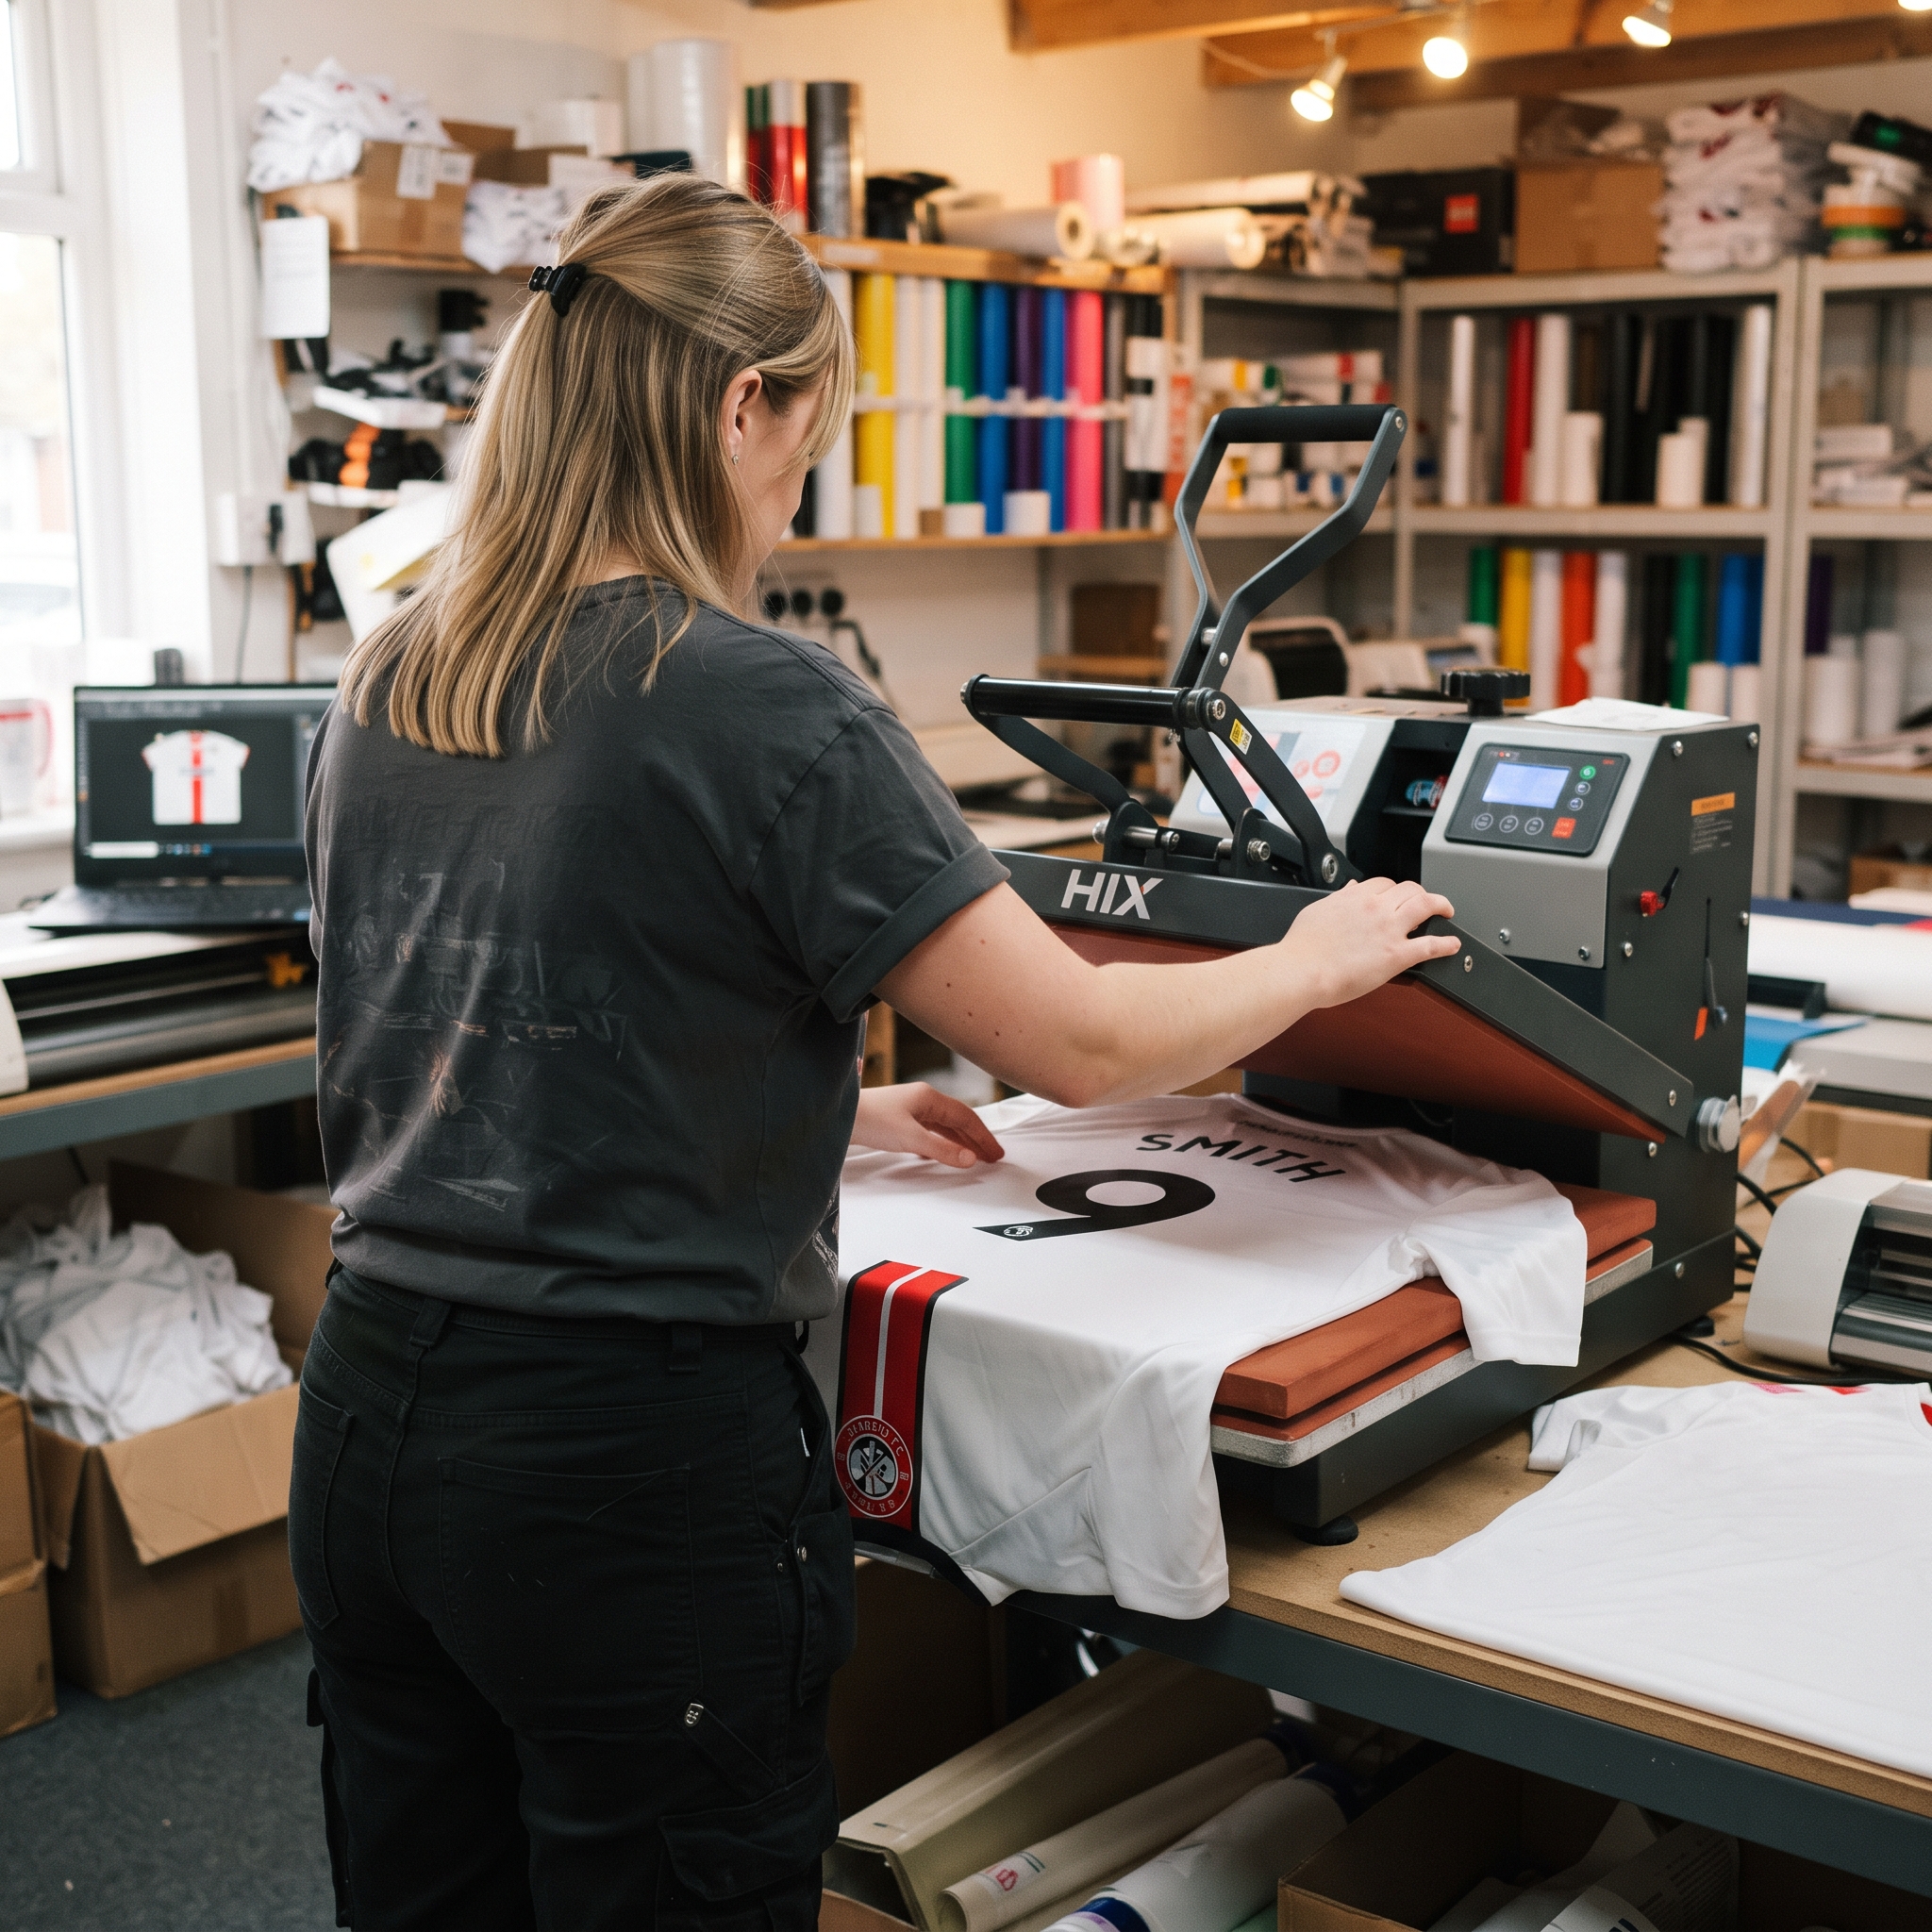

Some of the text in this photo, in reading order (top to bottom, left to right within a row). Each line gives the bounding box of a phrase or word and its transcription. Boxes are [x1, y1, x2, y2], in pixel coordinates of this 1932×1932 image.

[1060, 869, 1164, 921] HIX
[1135, 1134, 1347, 1183] SMITH
[972, 1169, 1216, 1242] 9
